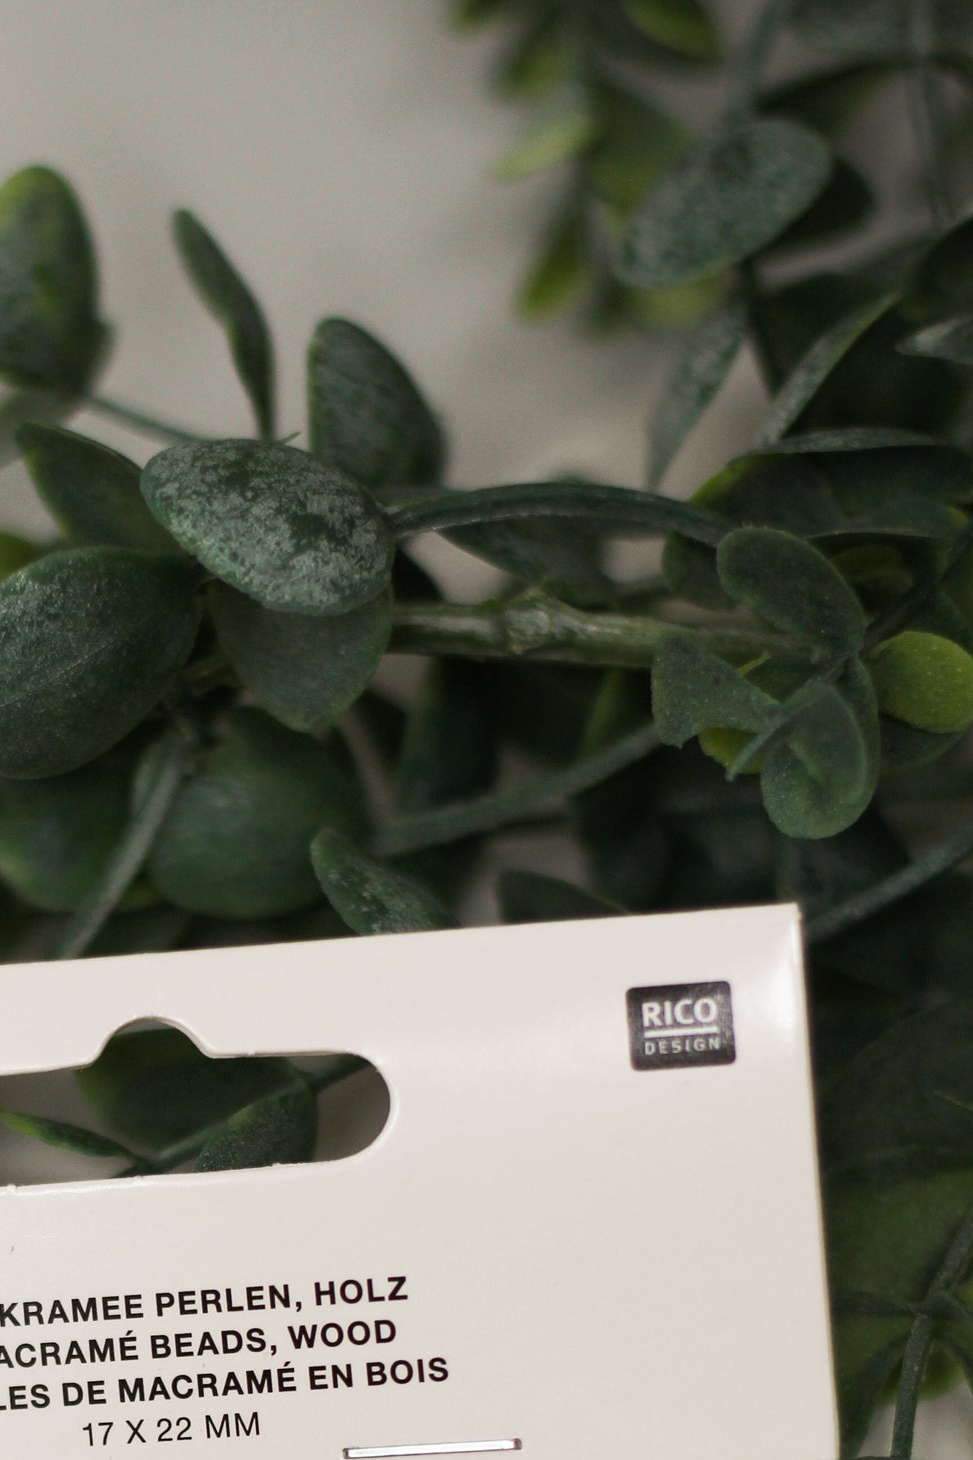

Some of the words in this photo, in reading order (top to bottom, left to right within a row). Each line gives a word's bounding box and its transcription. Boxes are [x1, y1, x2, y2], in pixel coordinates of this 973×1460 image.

[641, 997, 718, 1027] RICO
[644, 1036, 720, 1055] DESIGN
[155, 1283, 302, 1317] PERLEN,
[314, 1275, 409, 1307] HOLZ
[150, 1327, 277, 1360] BEADS,
[286, 1319, 397, 1350] WOOD
[61, 1379, 107, 1407] DE
[117, 1360, 297, 1403] MACRAMÉ
[308, 1363, 354, 1391] EN
[365, 1356, 449, 1387] BOIS
[82, 1421, 114, 1447] 17
[125, 1418, 147, 1445] X
[156, 1416, 193, 1443] 22
[204, 1411, 260, 1439] MM
